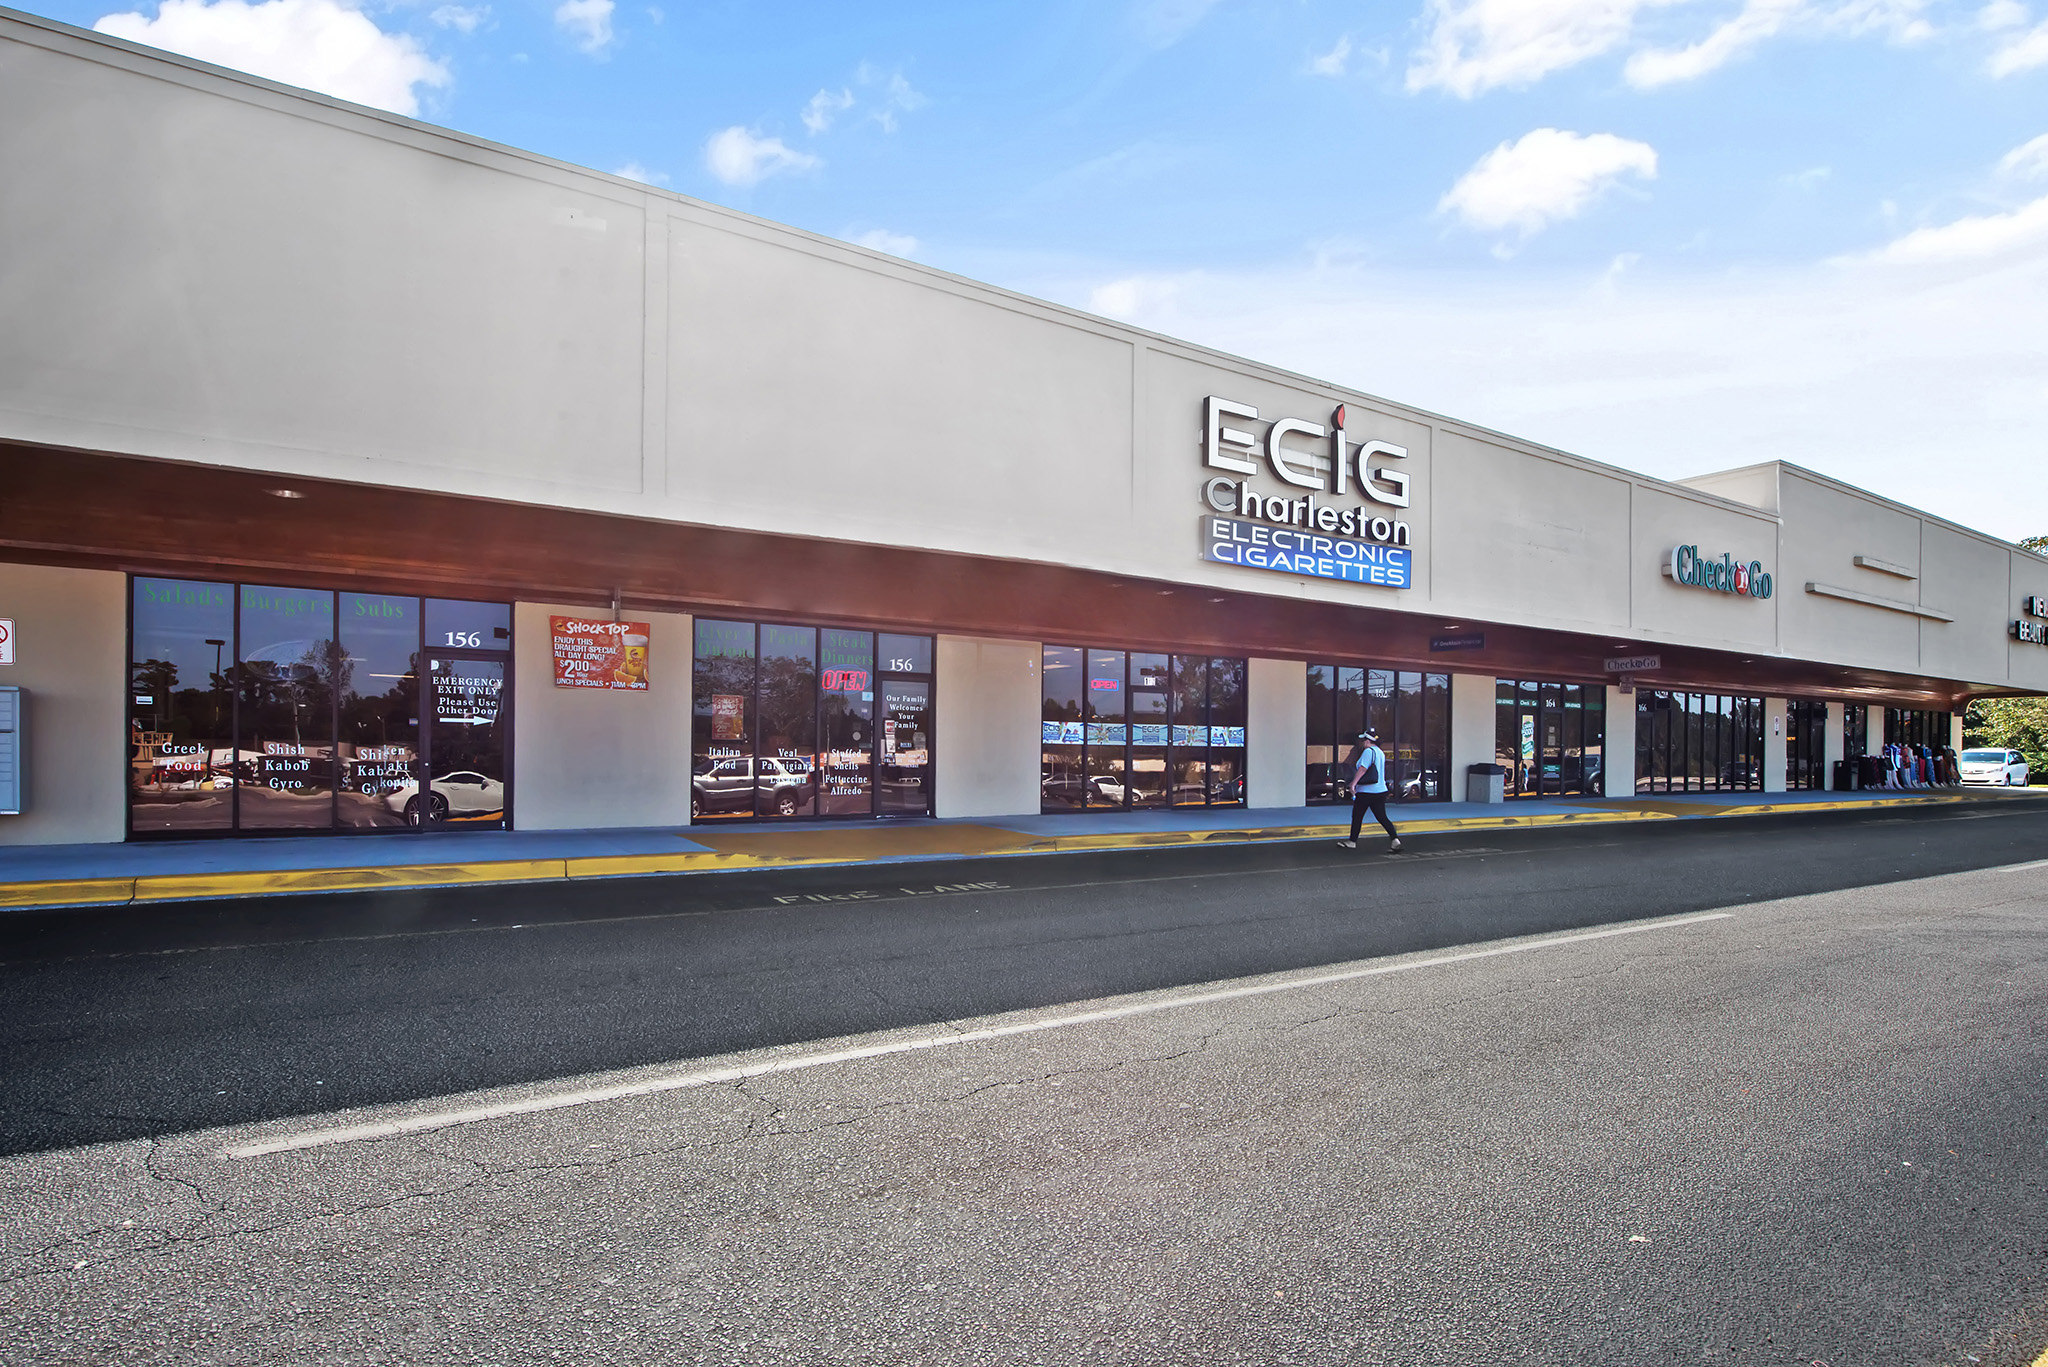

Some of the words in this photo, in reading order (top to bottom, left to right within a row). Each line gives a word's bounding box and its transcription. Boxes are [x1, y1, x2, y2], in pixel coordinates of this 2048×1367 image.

[1202, 476, 1410, 545] Charleston
[1212, 519, 1403, 566] ELECTRONIC
[1212, 543, 1404, 585] CIGARETTES
[144, 582, 223, 606] Salads
[242, 589, 331, 616] Burgers
[355, 598, 403, 618] Subs
[699, 623, 738, 640] Liver
[769, 628, 808, 646] Pasta
[445, 631, 481, 647] 156
[554, 636, 575, 644] ENJOY
[829, 632, 867, 649] Steak
[554, 643, 587, 653] DRAUGHT
[589, 646, 617, 654] SPECIAL
[698, 640, 755, 659] Onions
[583, 653, 605, 661] LONG!
[822, 649, 873, 666] Dinners
[889, 658, 913, 672] 156
[432, 676, 503, 686] EMERGENCY
[575, 679, 603, 687] SPECIALS
[822, 669, 867, 691] OPEN
[1091, 679, 1117, 690] OPEN
[437, 686, 464, 694] EXIT
[468, 686, 498, 695] ONLY
[439, 697, 474, 706] Please
[478, 698, 496, 706] Use
[886, 694, 900, 702] Our
[902, 695, 926, 704] Family
[437, 706, 468, 714] Other
[472, 706, 498, 715] Door
[894, 721, 918, 731] Family
[162, 742, 205, 754] Greek
[268, 743, 305, 755] Shish
[708, 747, 741, 756] Italian
[778, 749, 798, 757] Veal
[831, 749, 862, 758] Stuffed
[165, 760, 201, 771] Food
[265, 760, 309, 771] Kabob
[713, 761, 736, 770] Food
[834, 761, 859, 770] Shells
[269, 778, 303, 792] Gyro
[769, 775, 807, 786] Lasagna
[825, 775, 868, 784] Fettuccine
[830, 786, 862, 795] Alfredo
[900, 881, 1010, 895] LANE
